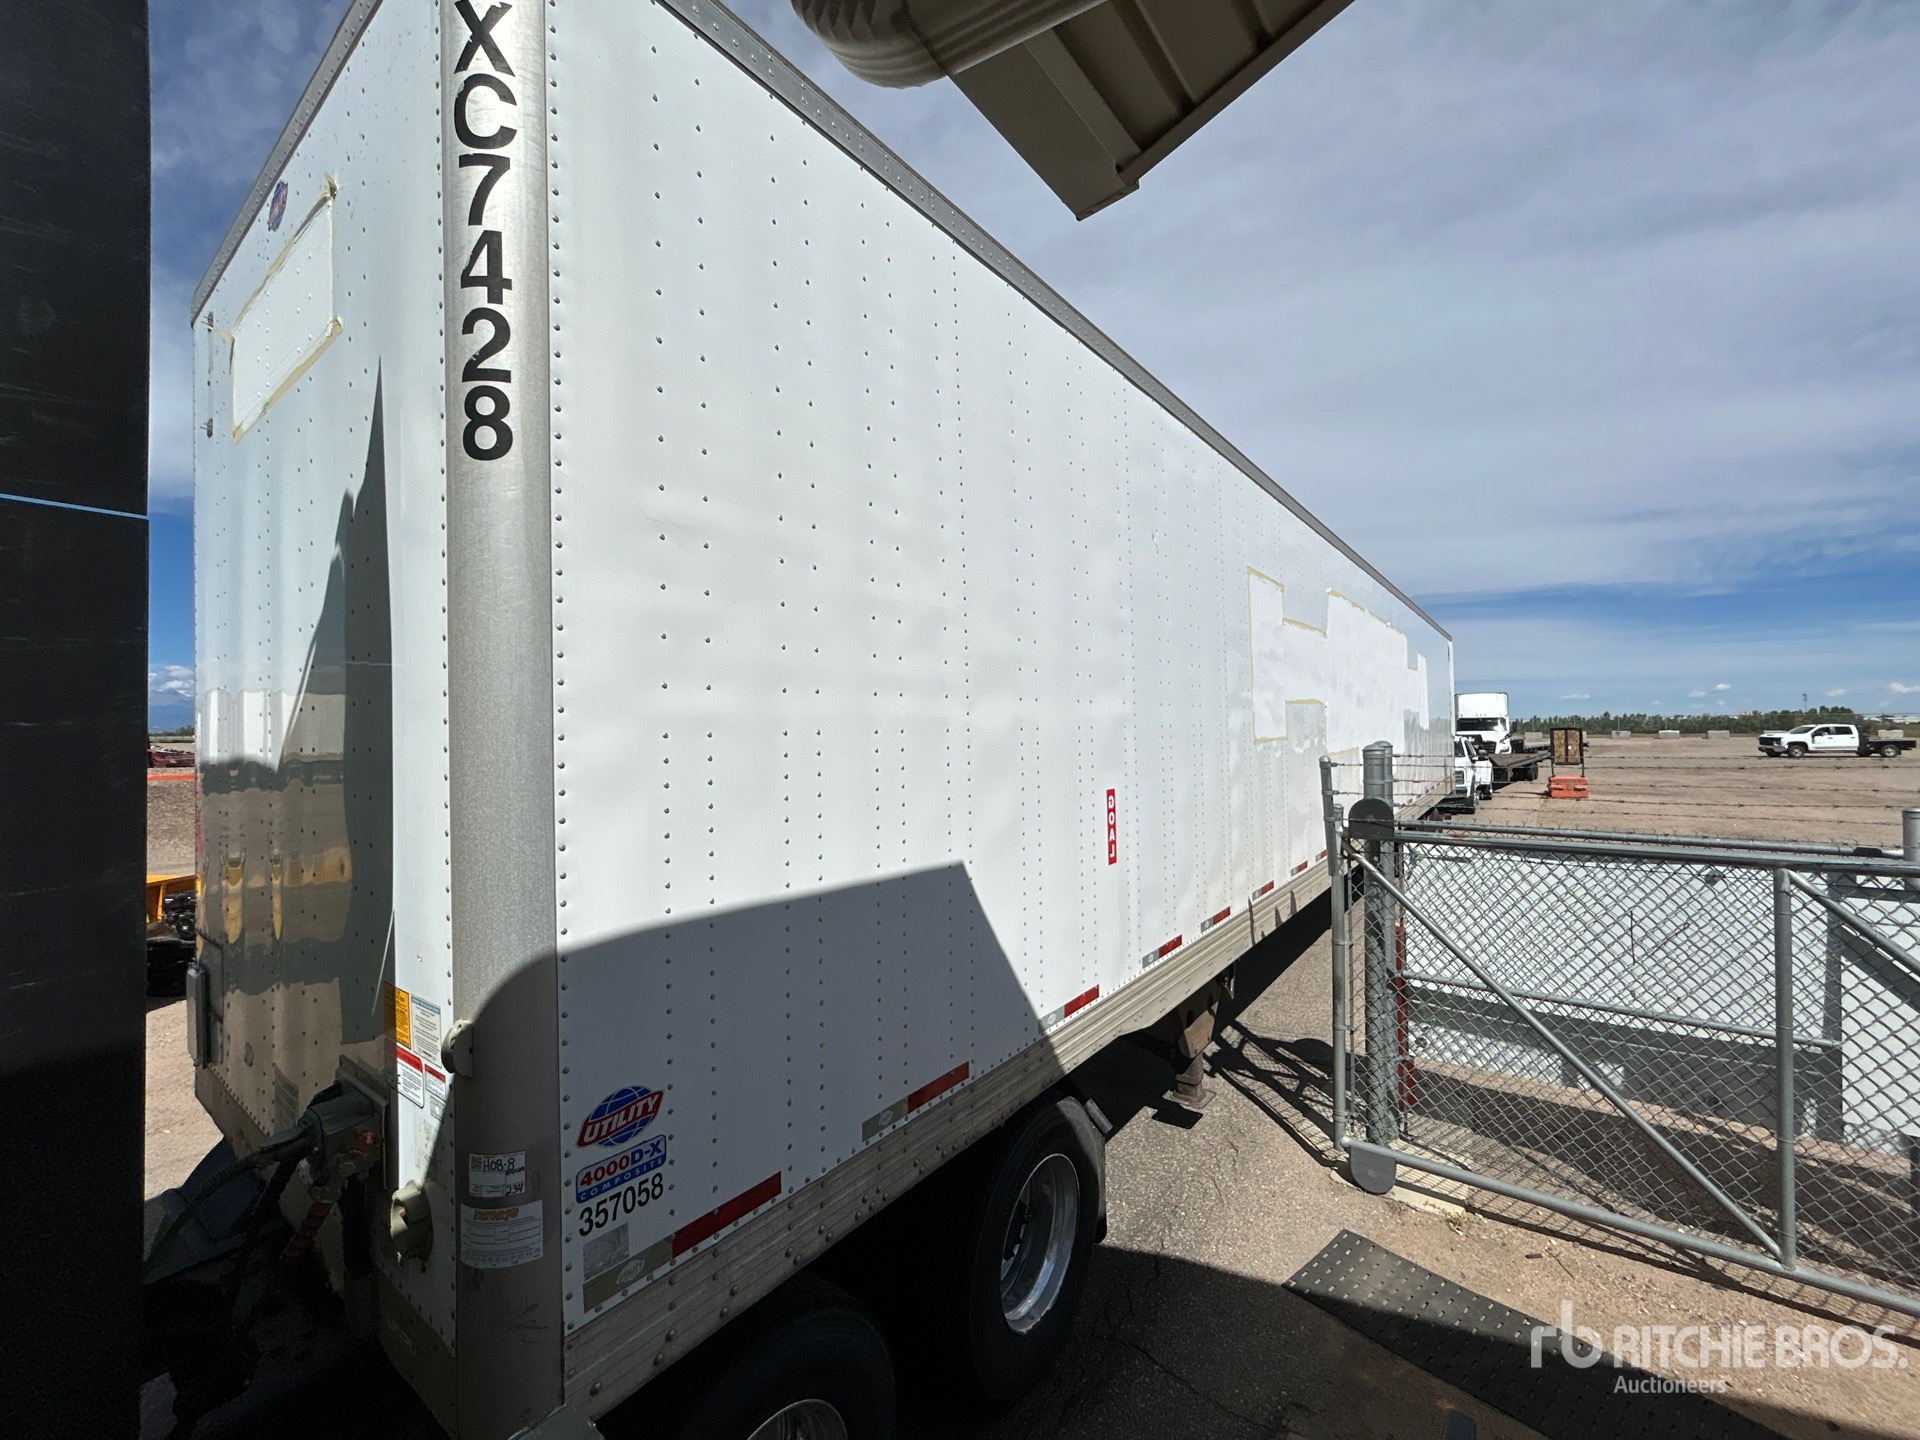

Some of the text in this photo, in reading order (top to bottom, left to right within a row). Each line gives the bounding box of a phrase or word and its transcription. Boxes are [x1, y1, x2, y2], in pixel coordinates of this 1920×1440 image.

[454, 0, 518, 461] XC7428
[583, 1092, 660, 1143] UTILITY
[579, 1173, 664, 1237] 357058
[580, 1157, 663, 1201] COMPOSITE
